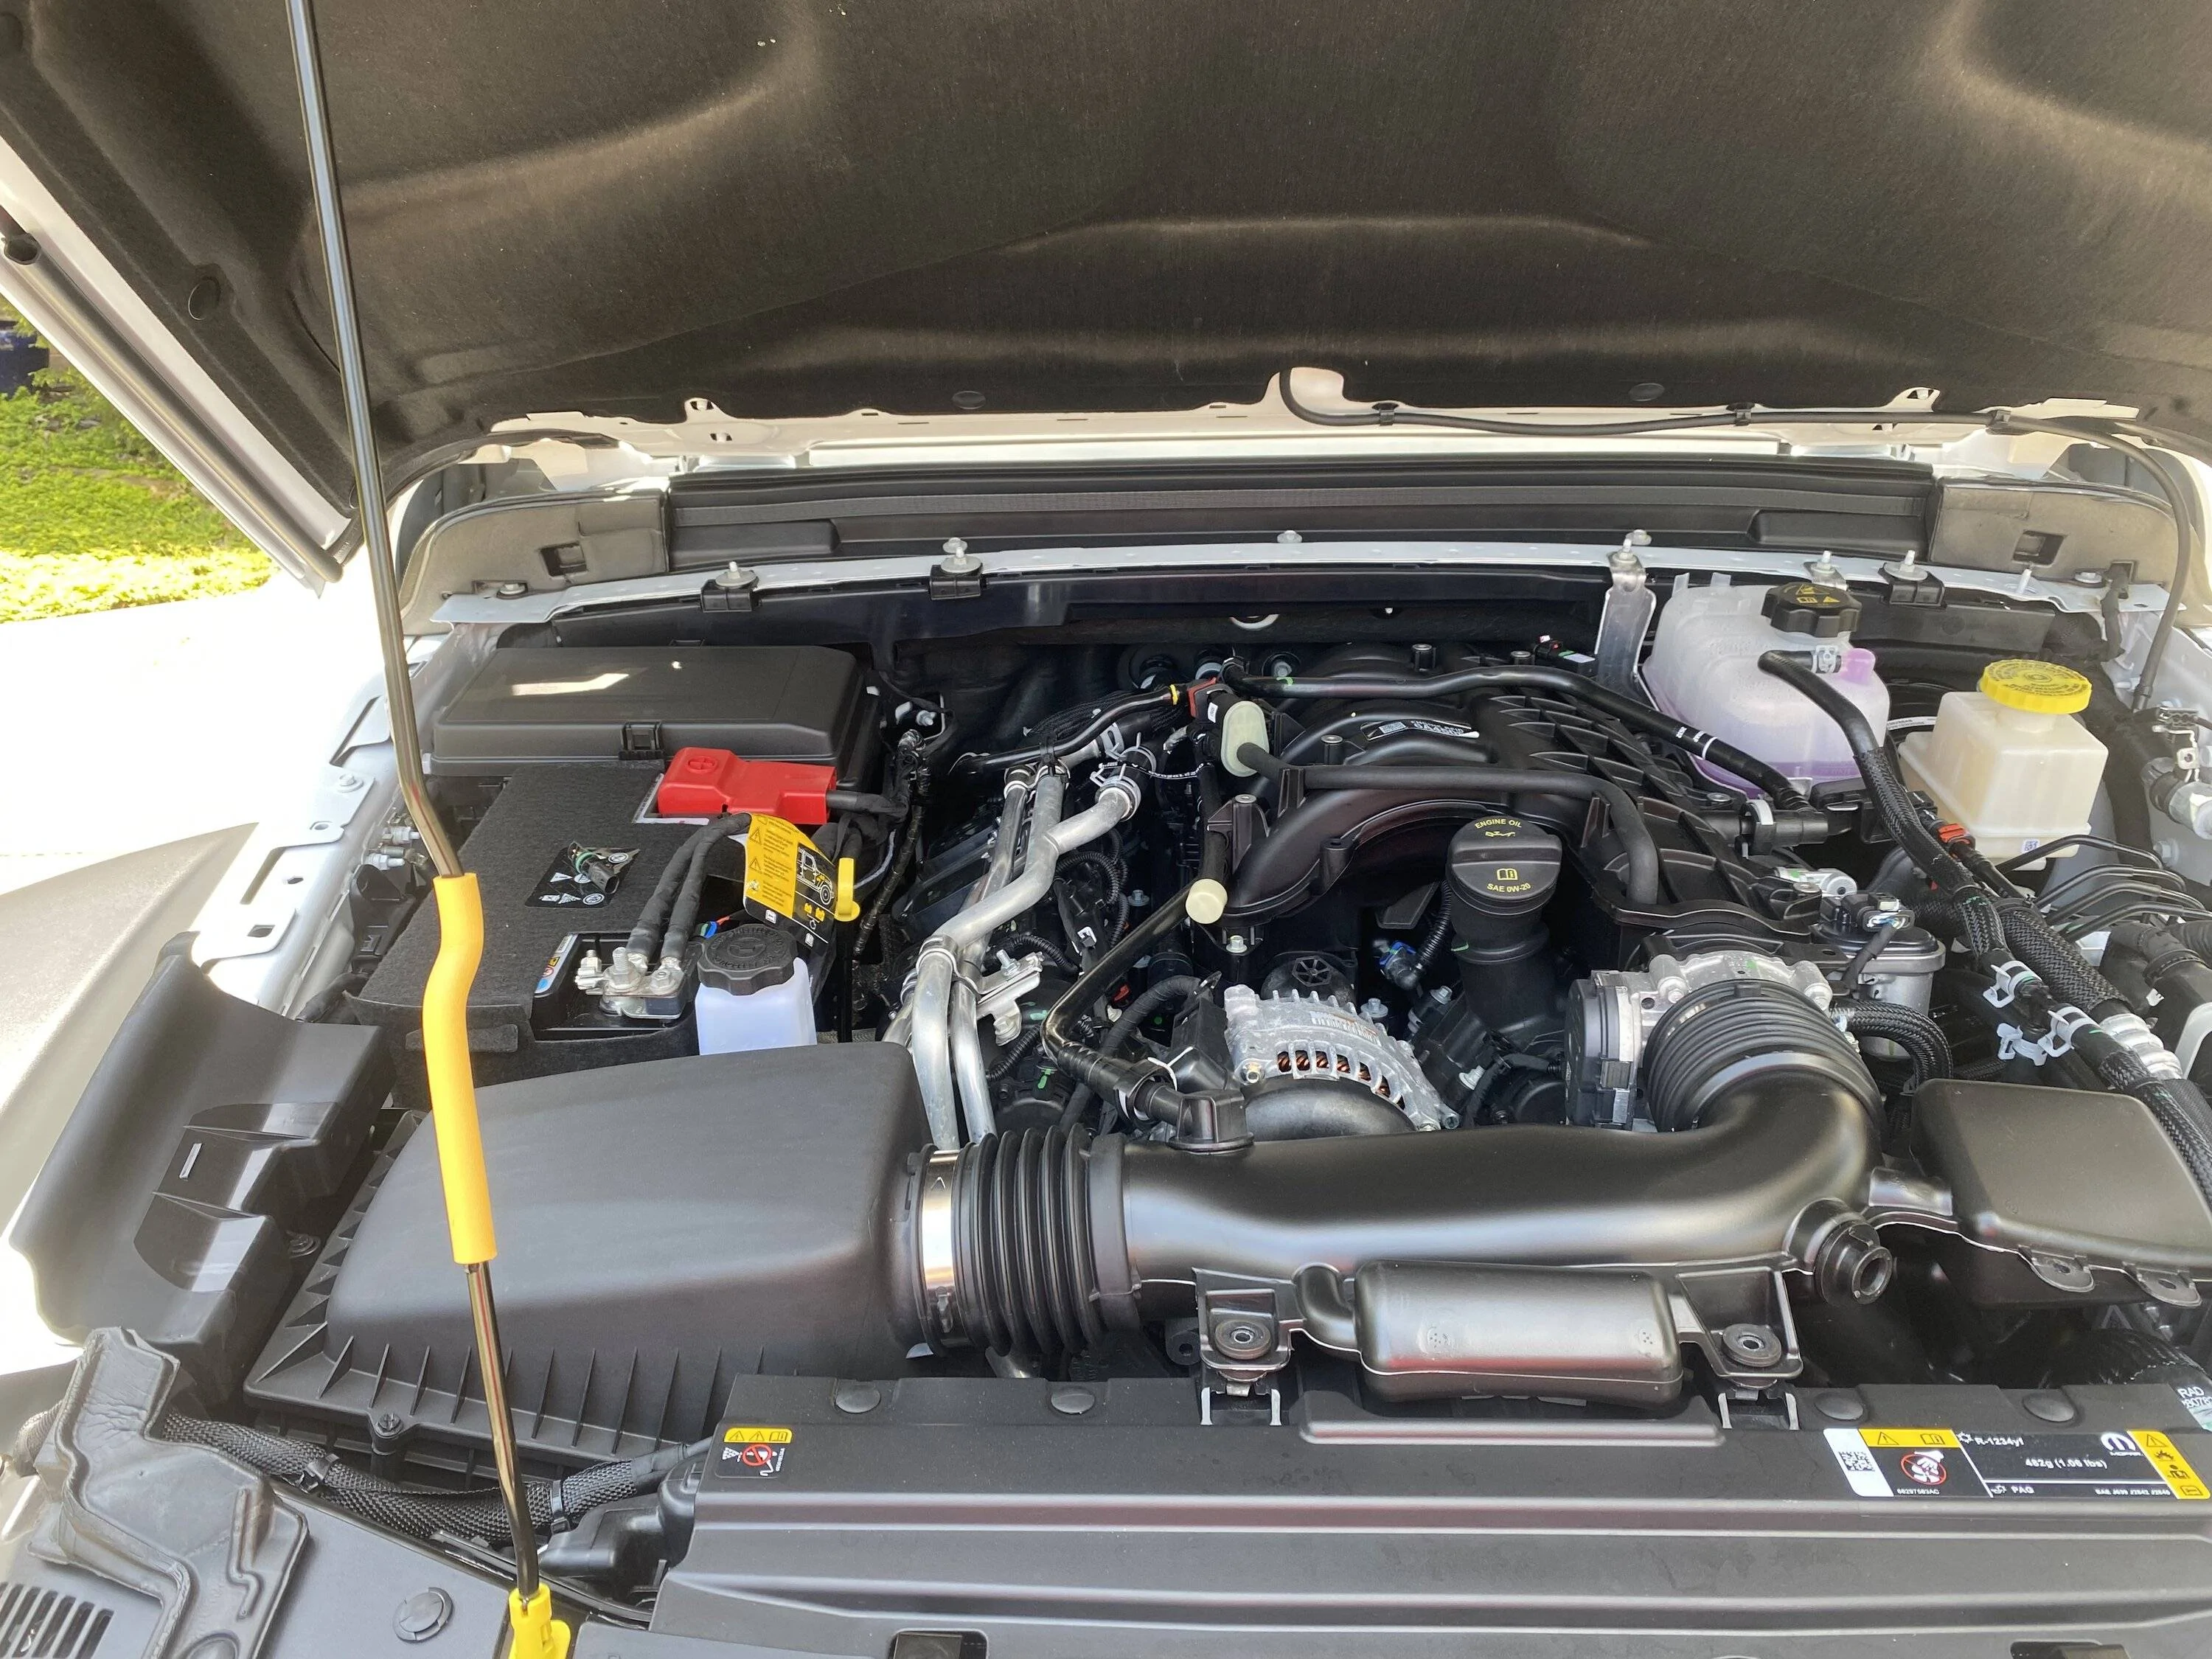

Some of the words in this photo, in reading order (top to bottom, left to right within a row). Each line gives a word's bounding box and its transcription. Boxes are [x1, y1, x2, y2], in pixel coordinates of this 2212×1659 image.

[1475, 818, 1506, 829] ENGINE
[1508, 820, 1523, 828] OIL
[1486, 883, 1505, 892] SAE
[1506, 883, 1531, 893] 0W-20
[2177, 1386, 2205, 1399] RAD
[1974, 1437, 2025, 1447] R-1234yf
[2011, 1486, 2035, 1495] PAG
